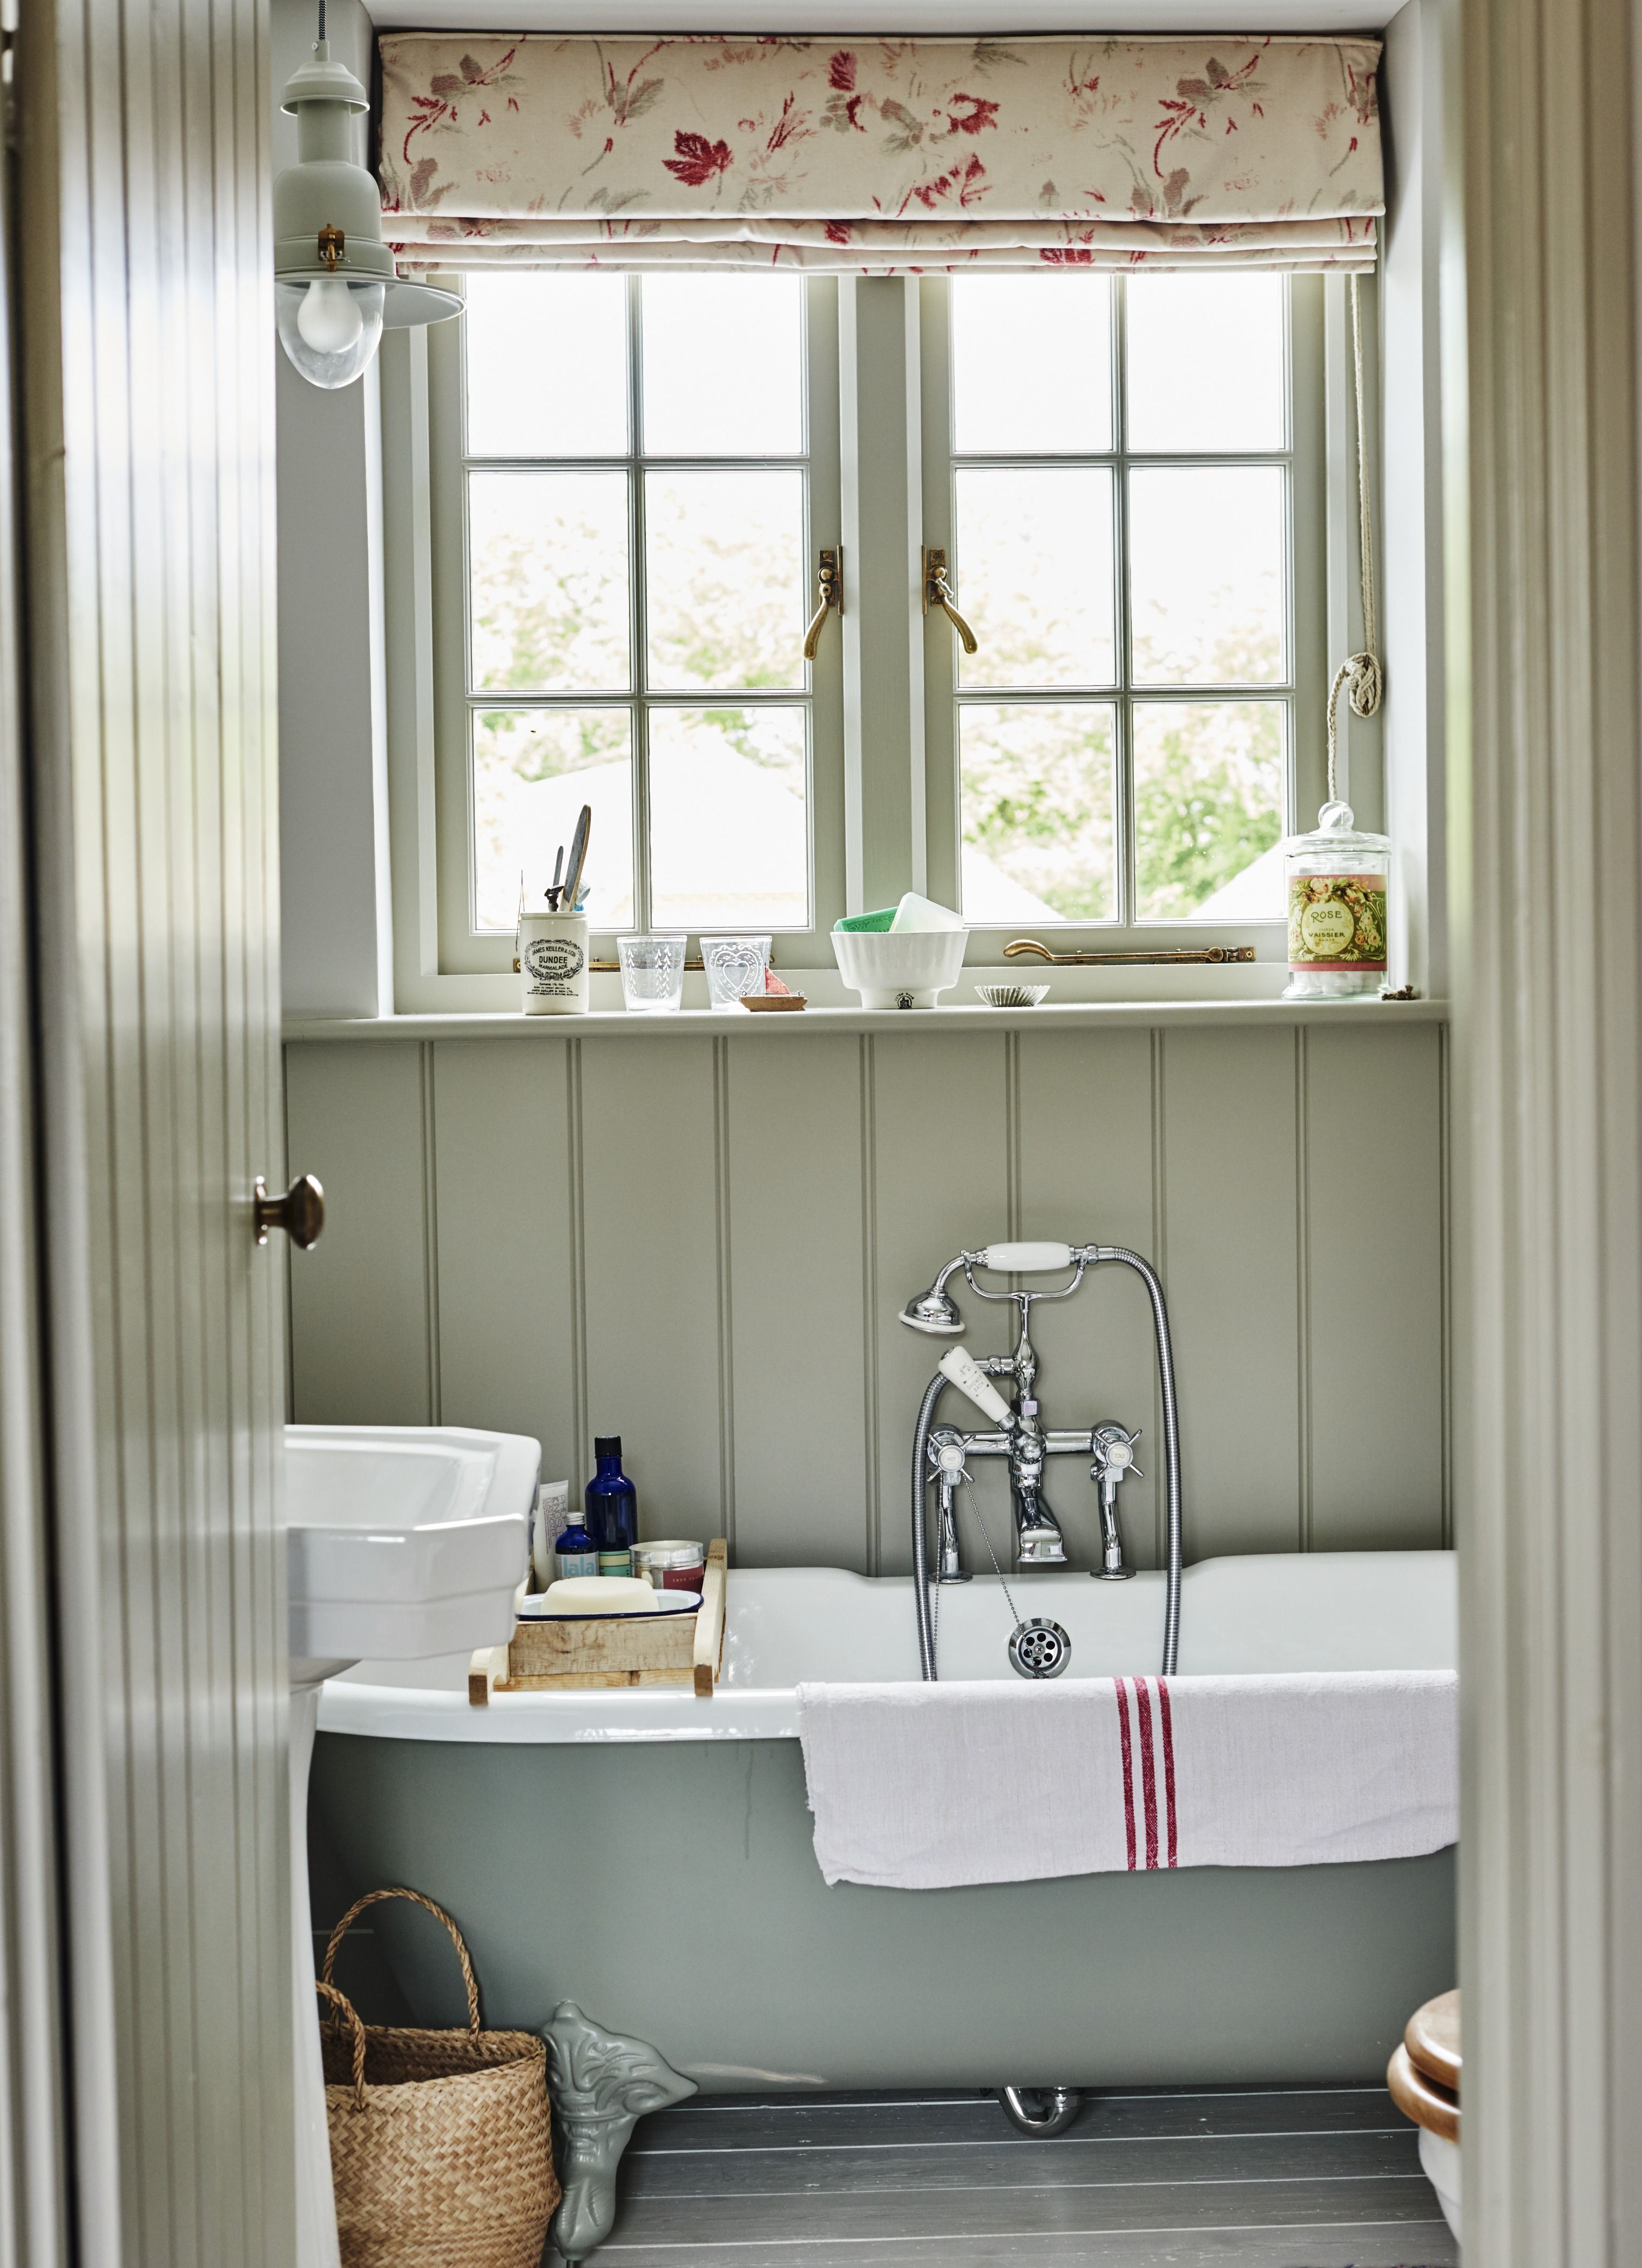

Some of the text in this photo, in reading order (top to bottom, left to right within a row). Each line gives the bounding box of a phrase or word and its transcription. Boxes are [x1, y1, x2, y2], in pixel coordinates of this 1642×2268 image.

[1310, 910, 1343, 923] ROSE
[532, 947, 545, 955] JAMES
[567, 949, 577, 957] SON
[539, 956, 568, 964] DUNDEE
[967, 1374, 982, 1390] SHOWER
[973, 1381, 984, 1392] BATH
[546, 1497, 556, 1537] ELASTICIZER
[563, 1555, 596, 1577] lala
